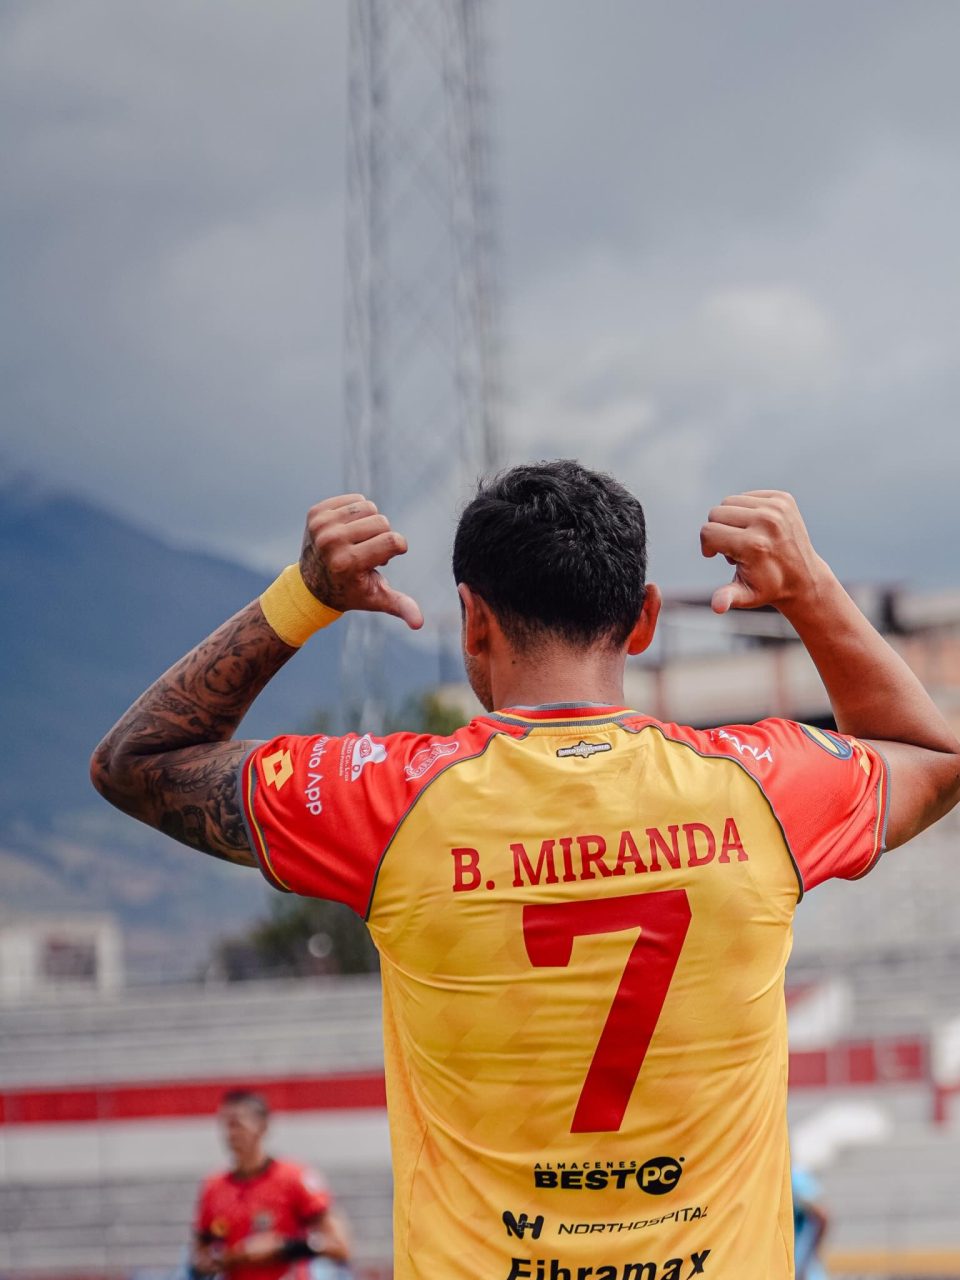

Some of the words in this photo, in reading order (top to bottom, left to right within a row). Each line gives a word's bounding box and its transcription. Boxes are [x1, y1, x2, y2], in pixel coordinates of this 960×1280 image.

[304, 773, 323, 816] App
[452, 847, 494, 892] B.
[511, 817, 748, 888] MIRANDA
[522, 889, 692, 1134] 7
[534, 1160, 637, 1170] ALMACENES
[558, 1206, 708, 1235] NORTHOSPITAL
